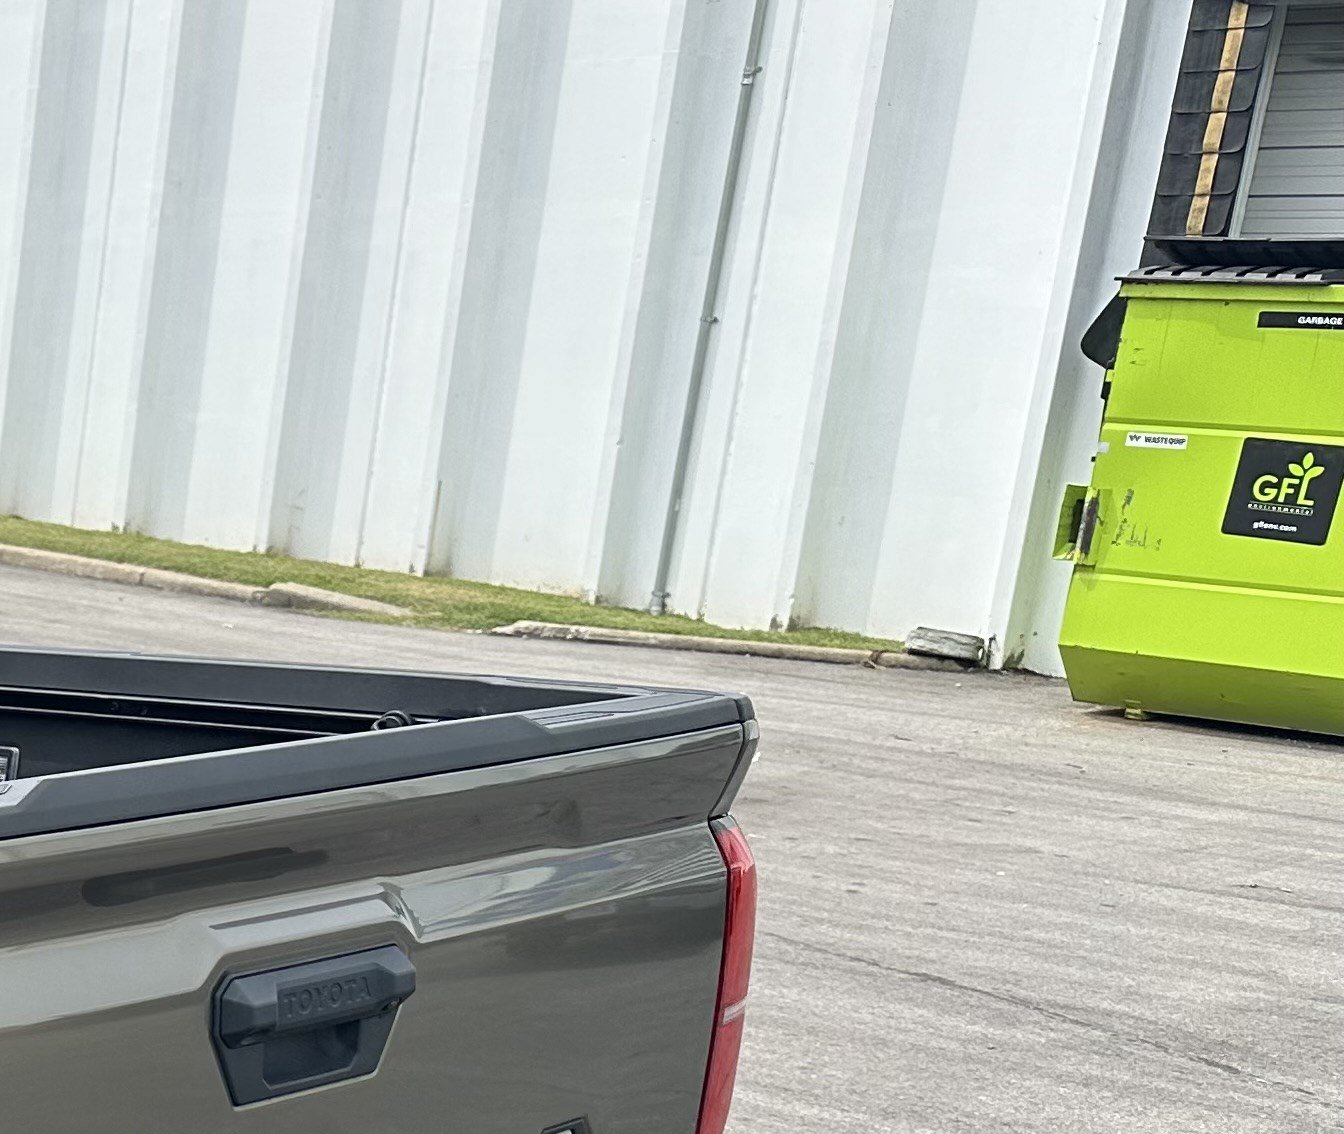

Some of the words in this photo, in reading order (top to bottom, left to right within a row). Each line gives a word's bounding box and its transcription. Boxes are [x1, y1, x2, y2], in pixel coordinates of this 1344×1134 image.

[1297, 315, 1344, 326] GARBAGE
[1252, 462, 1322, 506] GFL
[281, 975, 373, 1018] TOYOTA
